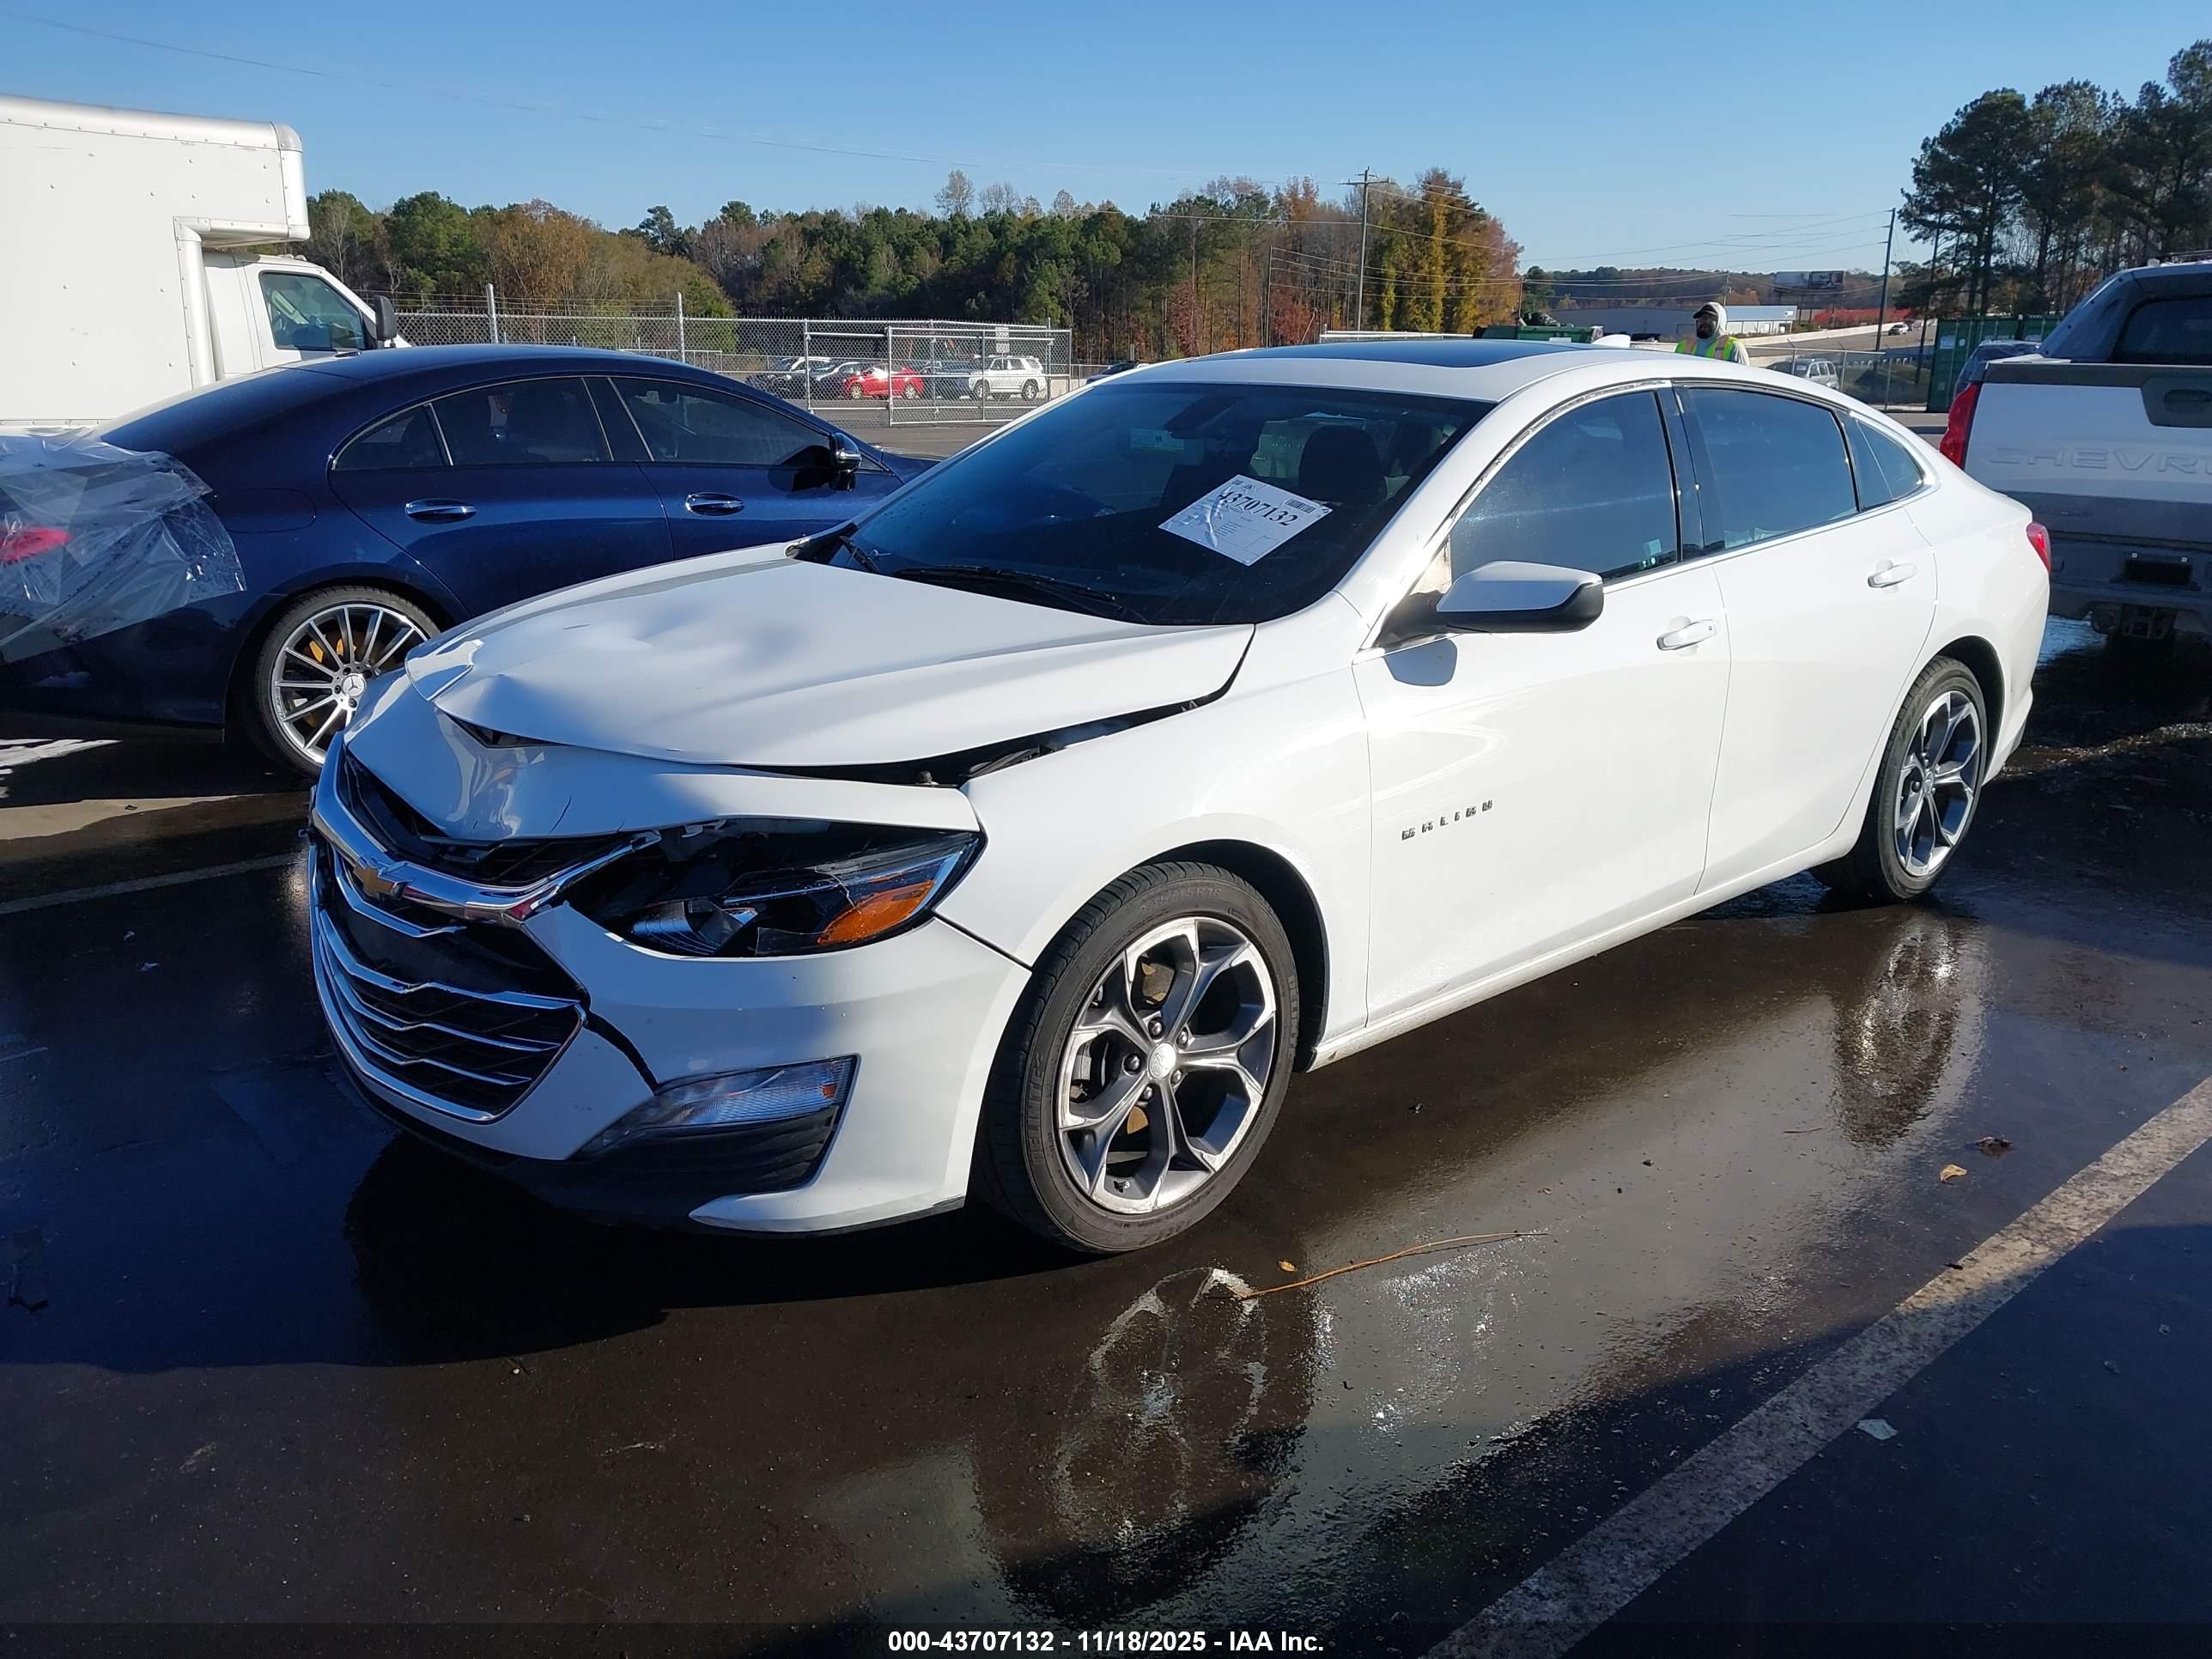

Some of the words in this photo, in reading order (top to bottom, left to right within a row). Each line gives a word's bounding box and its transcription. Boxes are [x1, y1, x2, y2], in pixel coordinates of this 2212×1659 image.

[1989, 447, 2212, 475] CHEVR
[1217, 491, 1298, 526] 43707132
[1401, 799, 1492, 841] MALIBU
